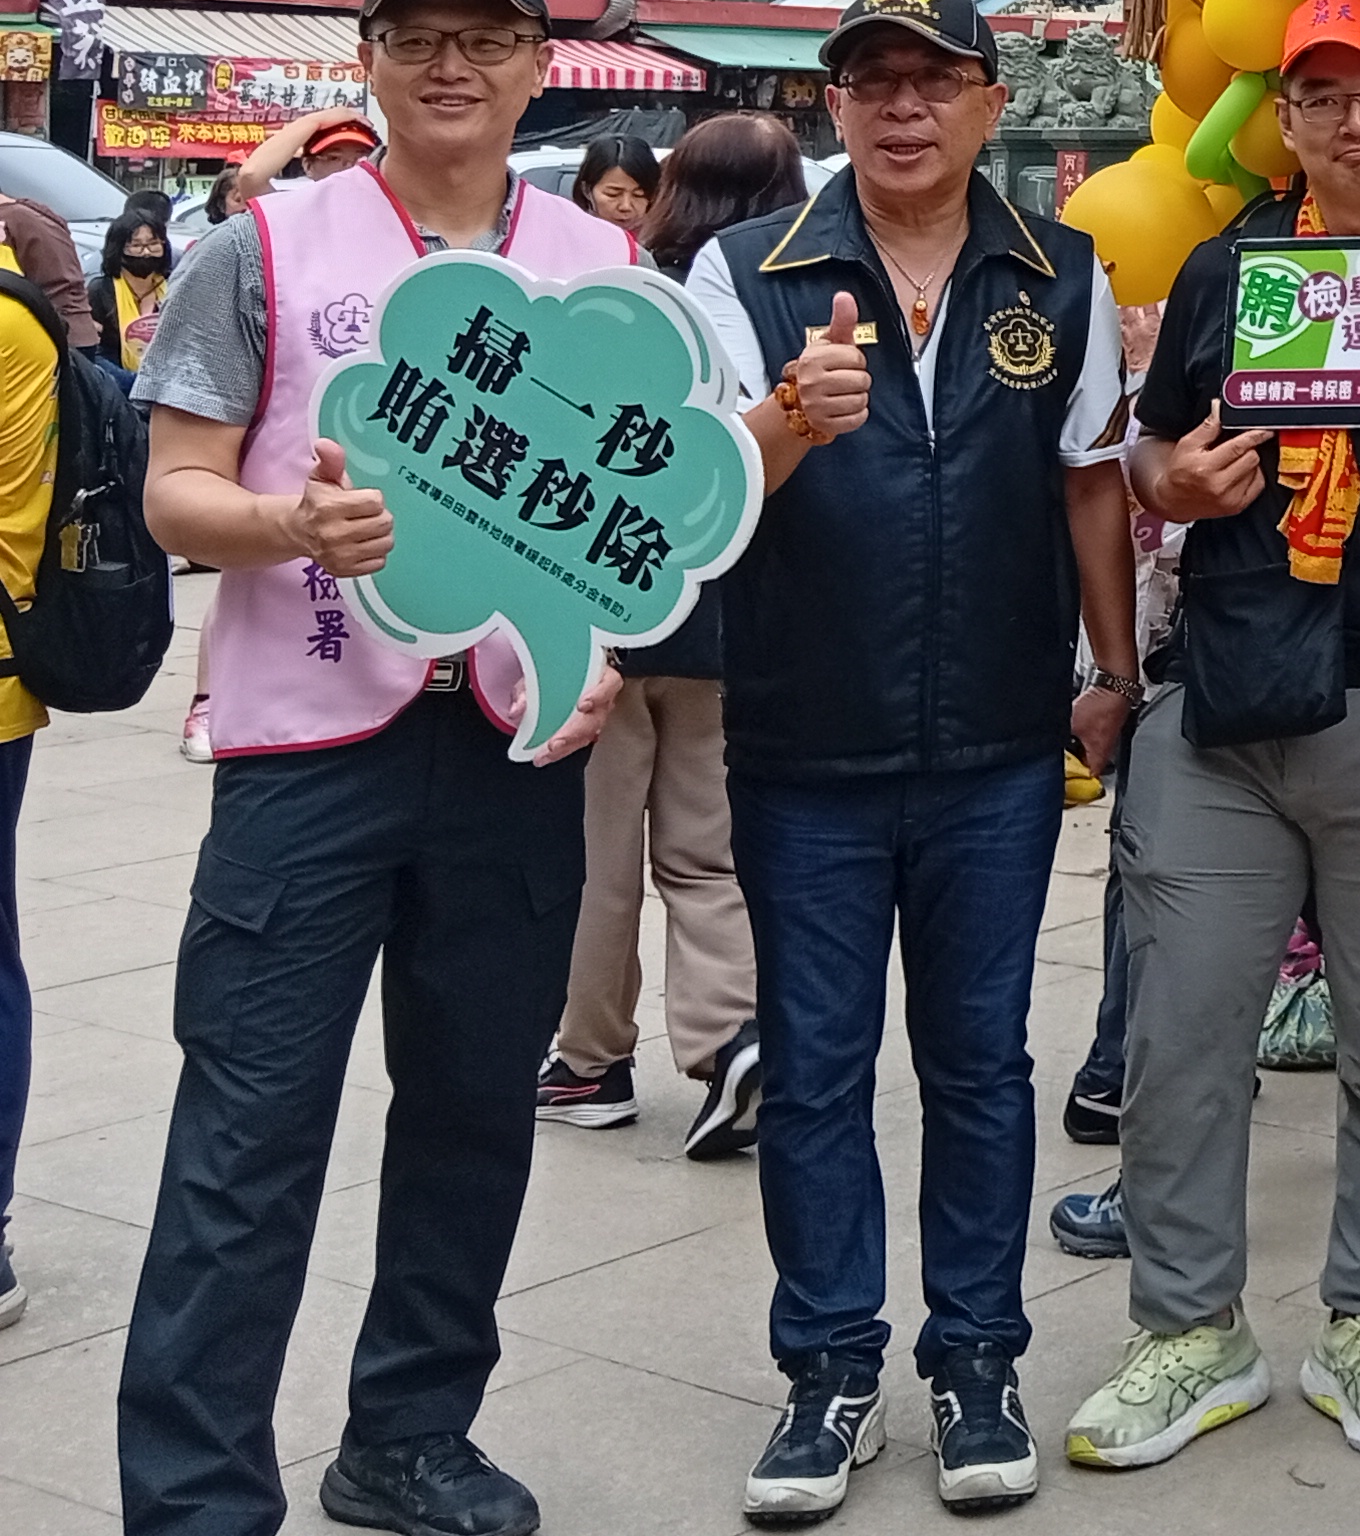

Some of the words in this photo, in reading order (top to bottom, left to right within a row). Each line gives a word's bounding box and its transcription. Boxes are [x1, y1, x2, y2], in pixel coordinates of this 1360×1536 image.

[366, 357, 673, 593] 賄選秒除
[445, 305, 678, 477] 掃一秒
